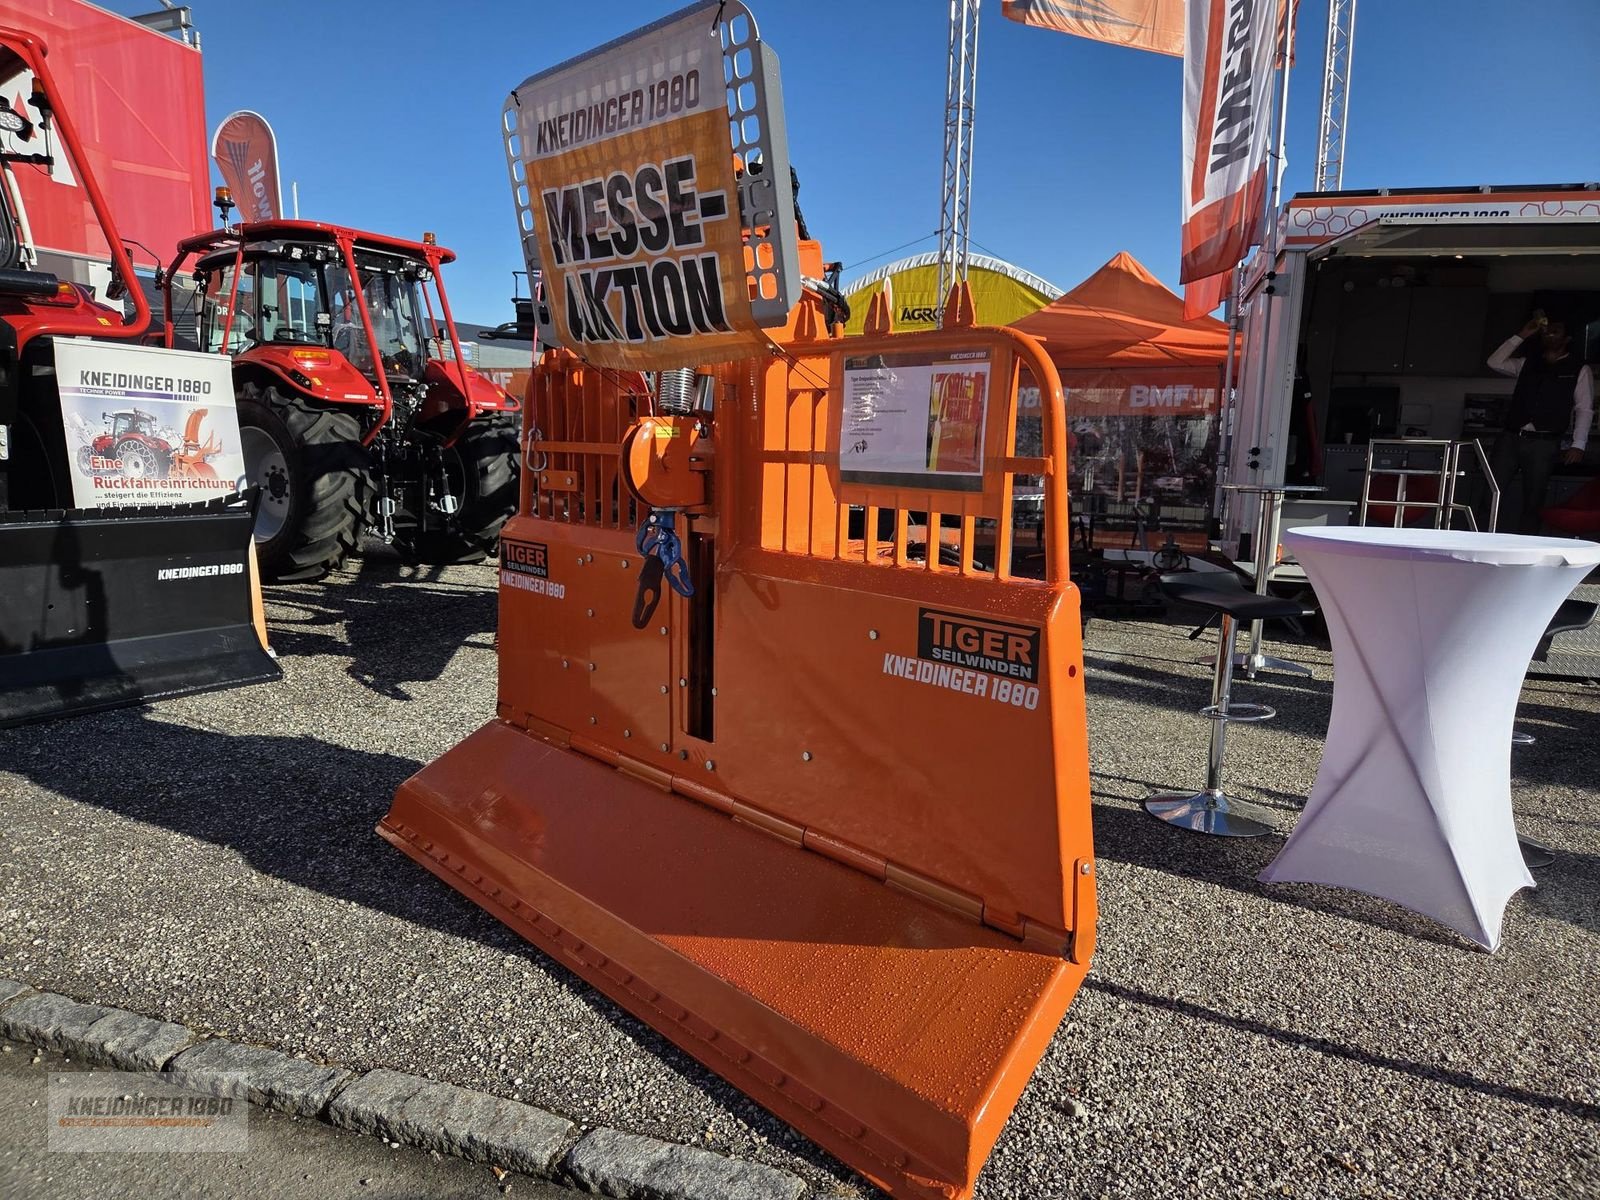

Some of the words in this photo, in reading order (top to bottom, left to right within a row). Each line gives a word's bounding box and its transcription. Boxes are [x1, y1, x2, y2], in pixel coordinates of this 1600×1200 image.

[536, 88, 644, 154] KNEIDINGER
[648, 69, 700, 121] 1880
[542, 157, 727, 266] MESSE-
[565, 254, 733, 342] AKTION
[80, 370, 174, 392] KNEIDINGER
[177, 378, 211, 395] 1880
[91, 456, 123, 469] Eine
[94, 476, 236, 491] Rückfahreinrichtung
[104, 491, 135, 500] steigert
[136, 491, 148, 499] die
[150, 491, 182, 499] Effizienz
[96, 501, 111, 509] und
[502, 540, 546, 567] TIGER
[158, 565, 219, 580] KNEIDINGER
[220, 563, 243, 575] 1880
[507, 561, 546, 576] SEILWINDEN
[501, 570, 545, 594] KNEIDINGER
[545, 581, 565, 600] 1880
[922, 611, 1038, 665] TIGER
[931, 647, 1032, 679] SEILWINDEN
[882, 653, 988, 697] KNEIDINGER
[990, 677, 1040, 710] 1880
